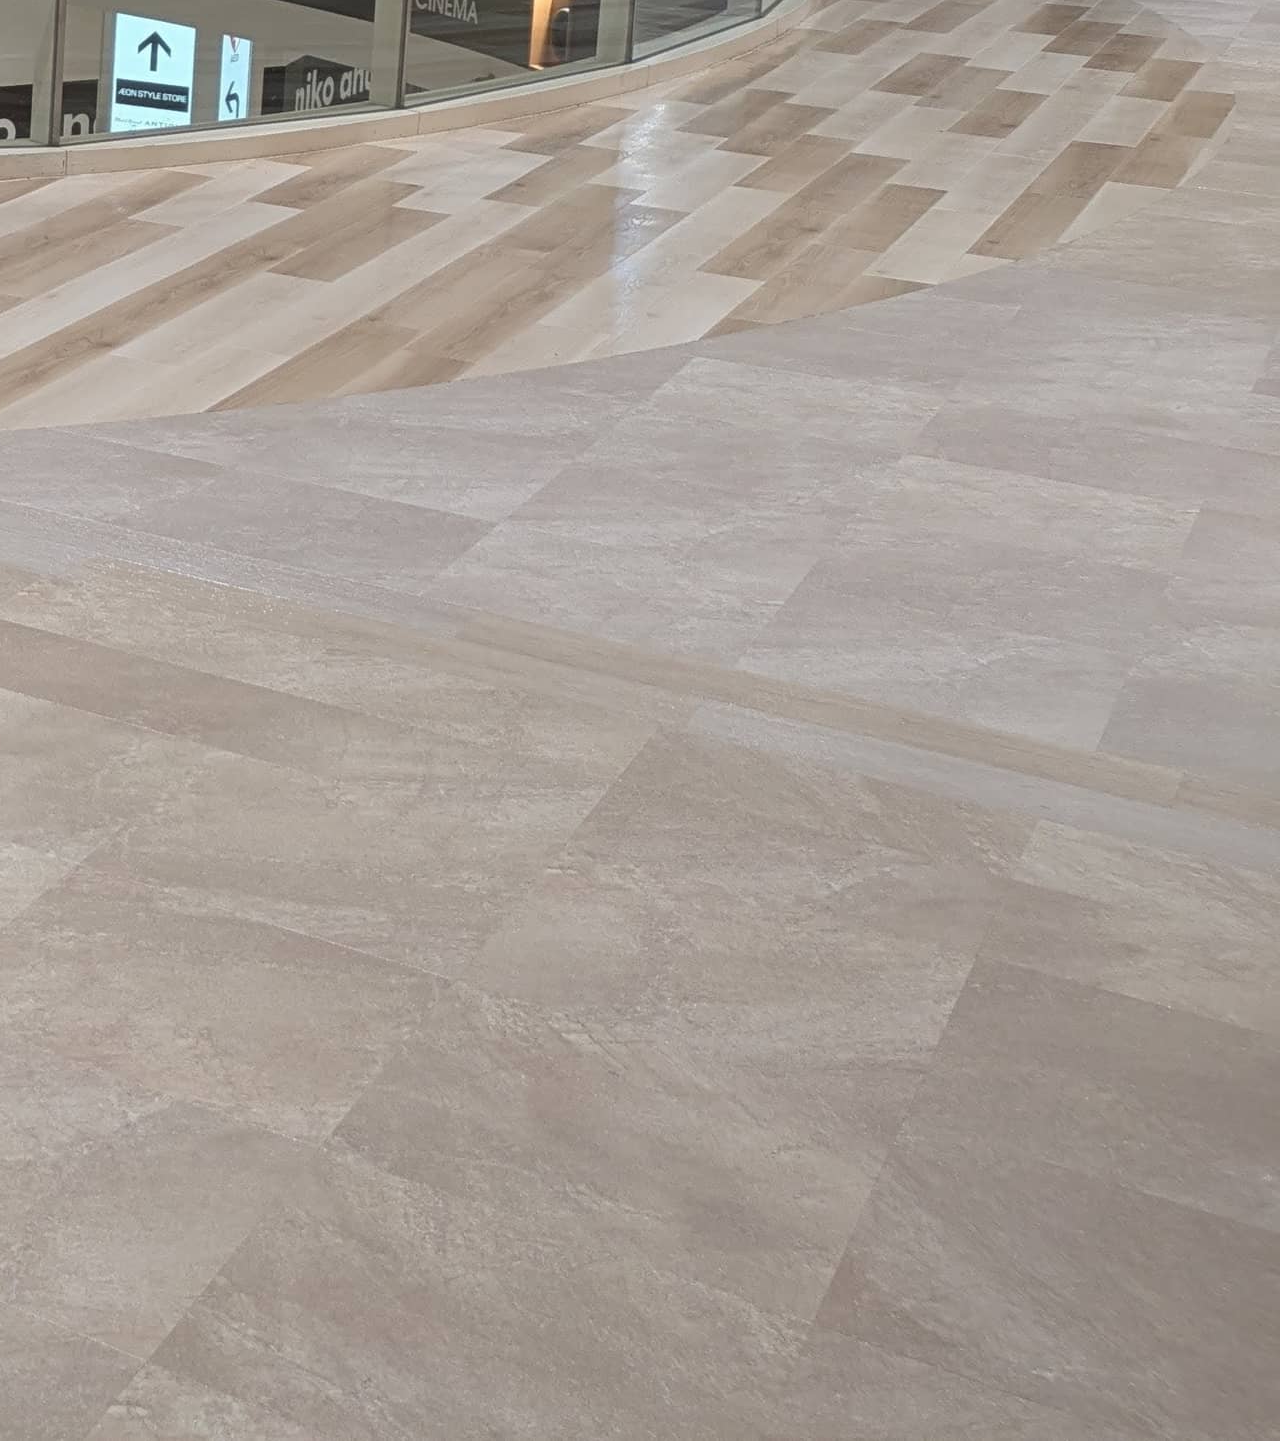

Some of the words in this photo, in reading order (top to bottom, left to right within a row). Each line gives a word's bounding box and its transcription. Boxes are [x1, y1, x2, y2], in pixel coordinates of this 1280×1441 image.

[138, 90, 162, 100] STYLE
[162, 92, 188, 103] STORE
[295, 69, 334, 112] niko
